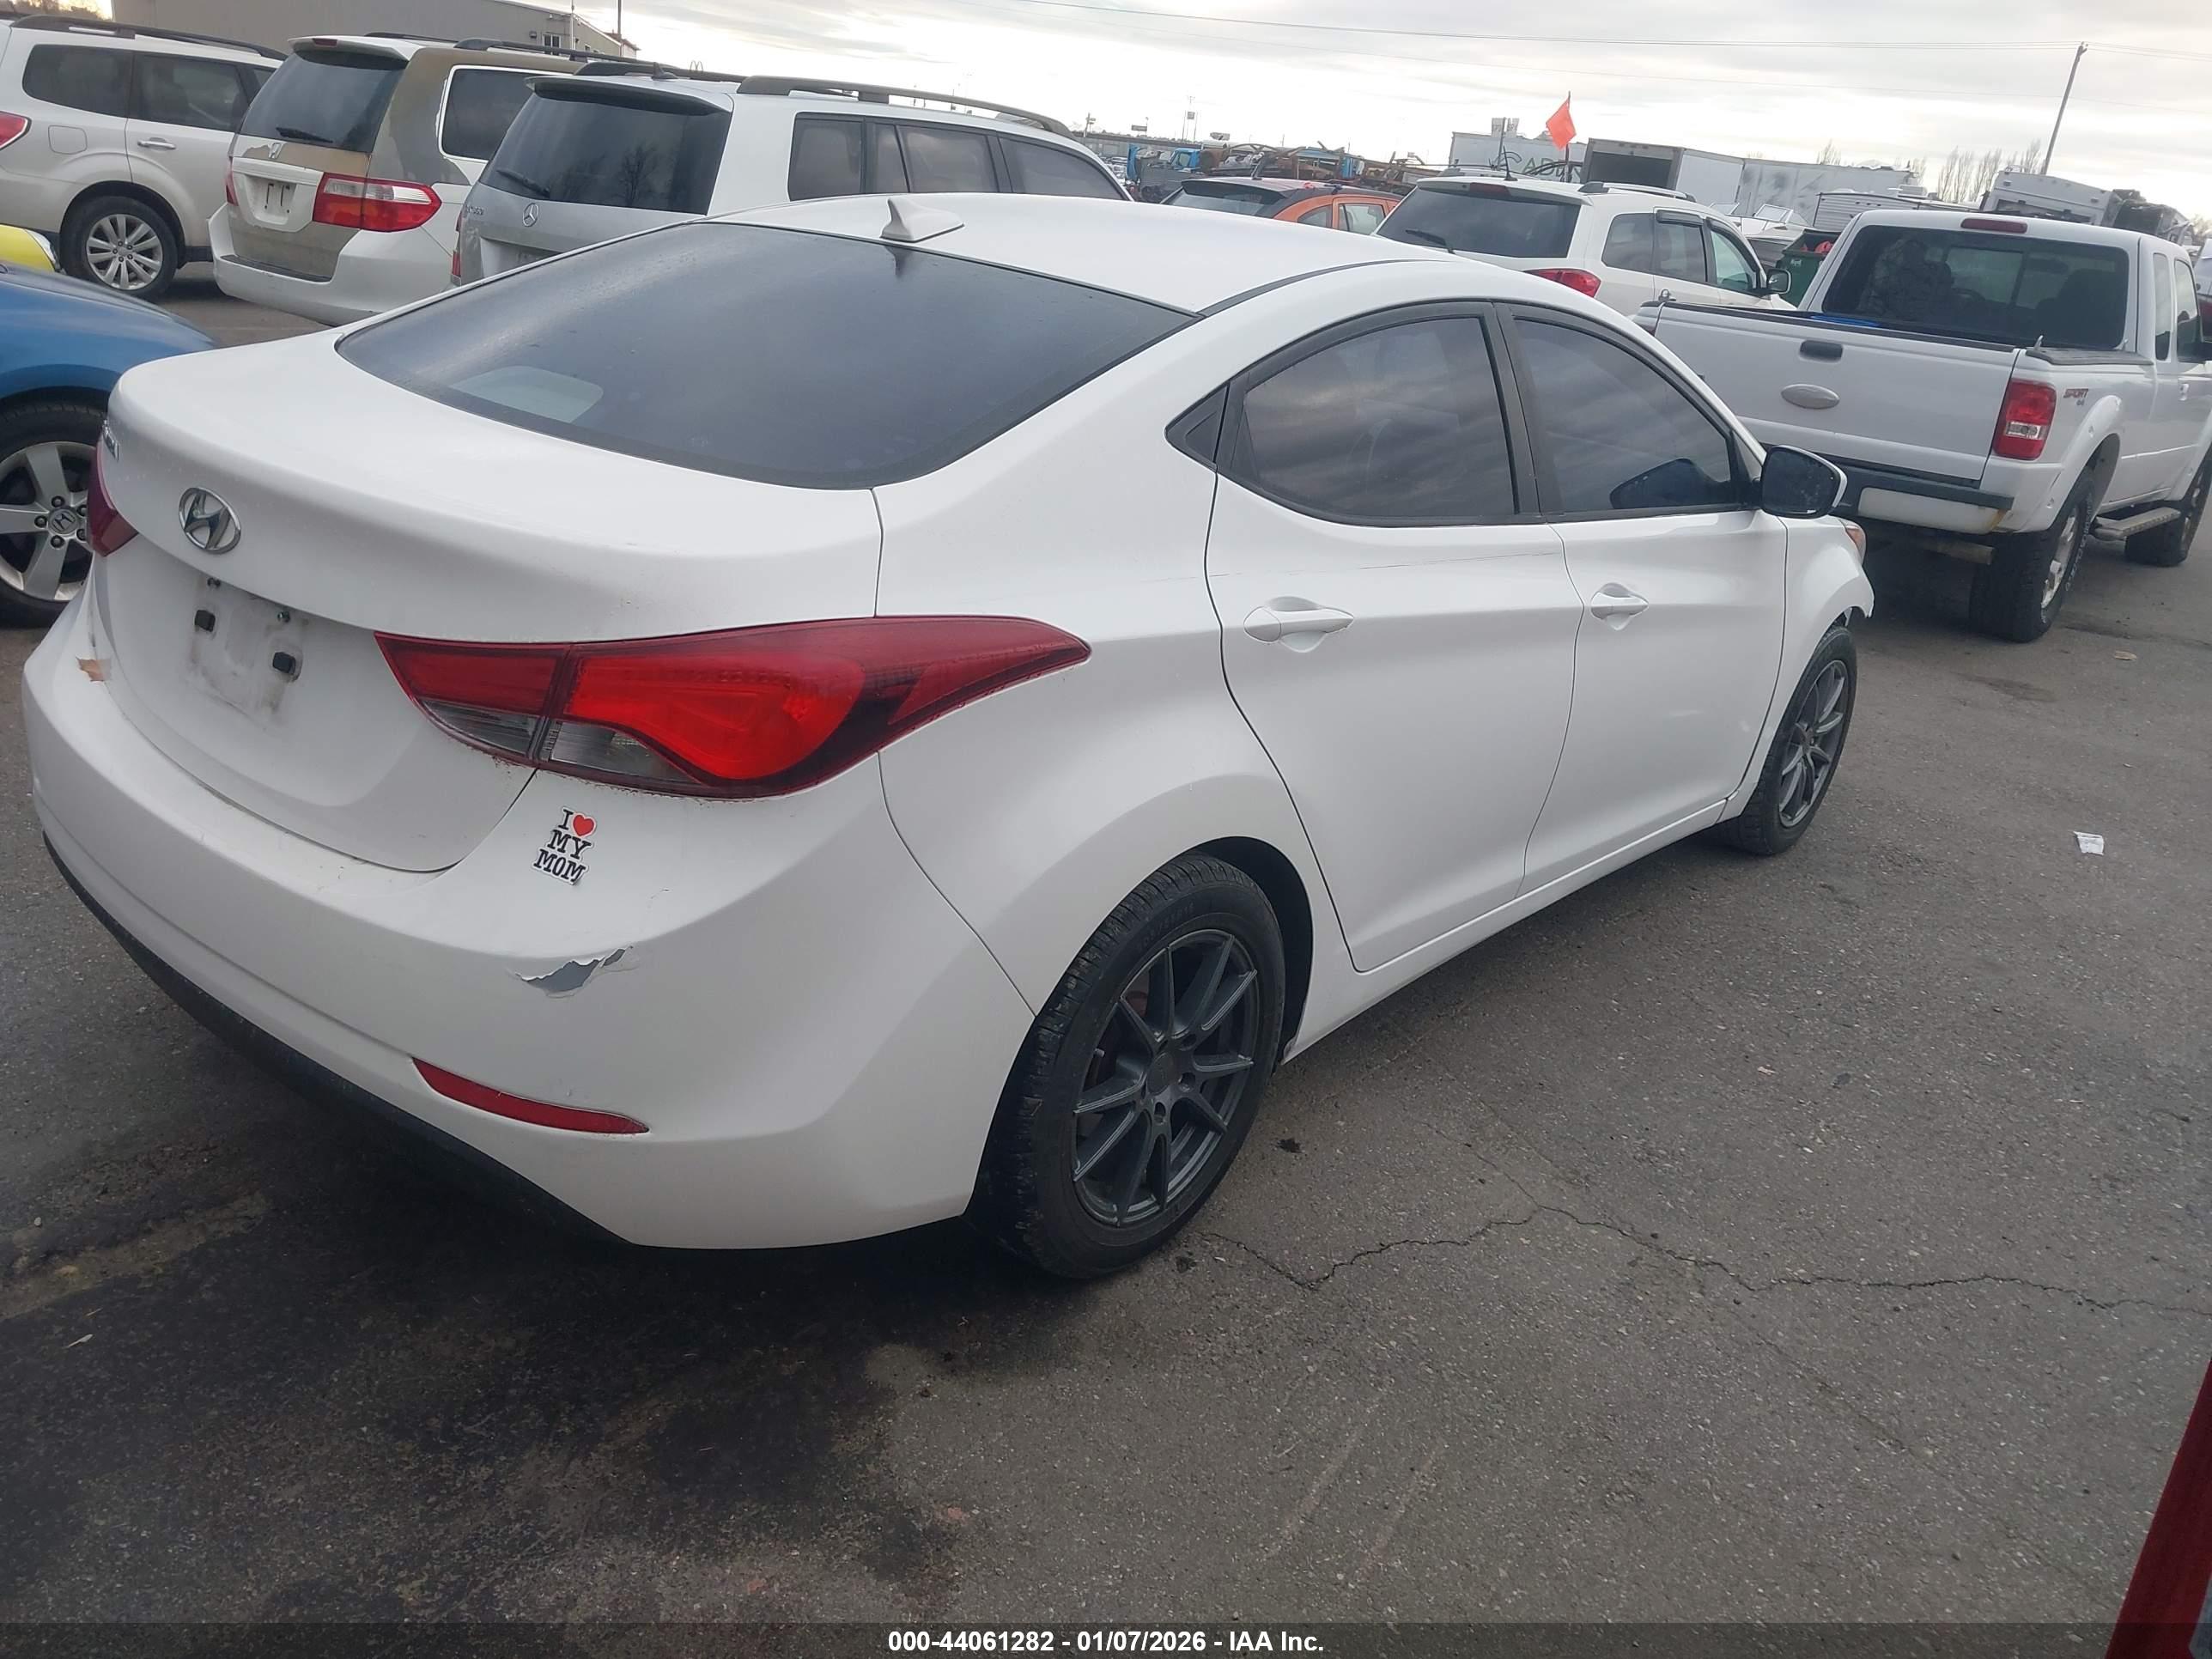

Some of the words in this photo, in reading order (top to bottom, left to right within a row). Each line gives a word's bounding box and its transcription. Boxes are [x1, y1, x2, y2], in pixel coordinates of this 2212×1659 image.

[558, 809, 574, 830] I
[547, 830, 592, 860] MY
[533, 848, 586, 883] MOM
